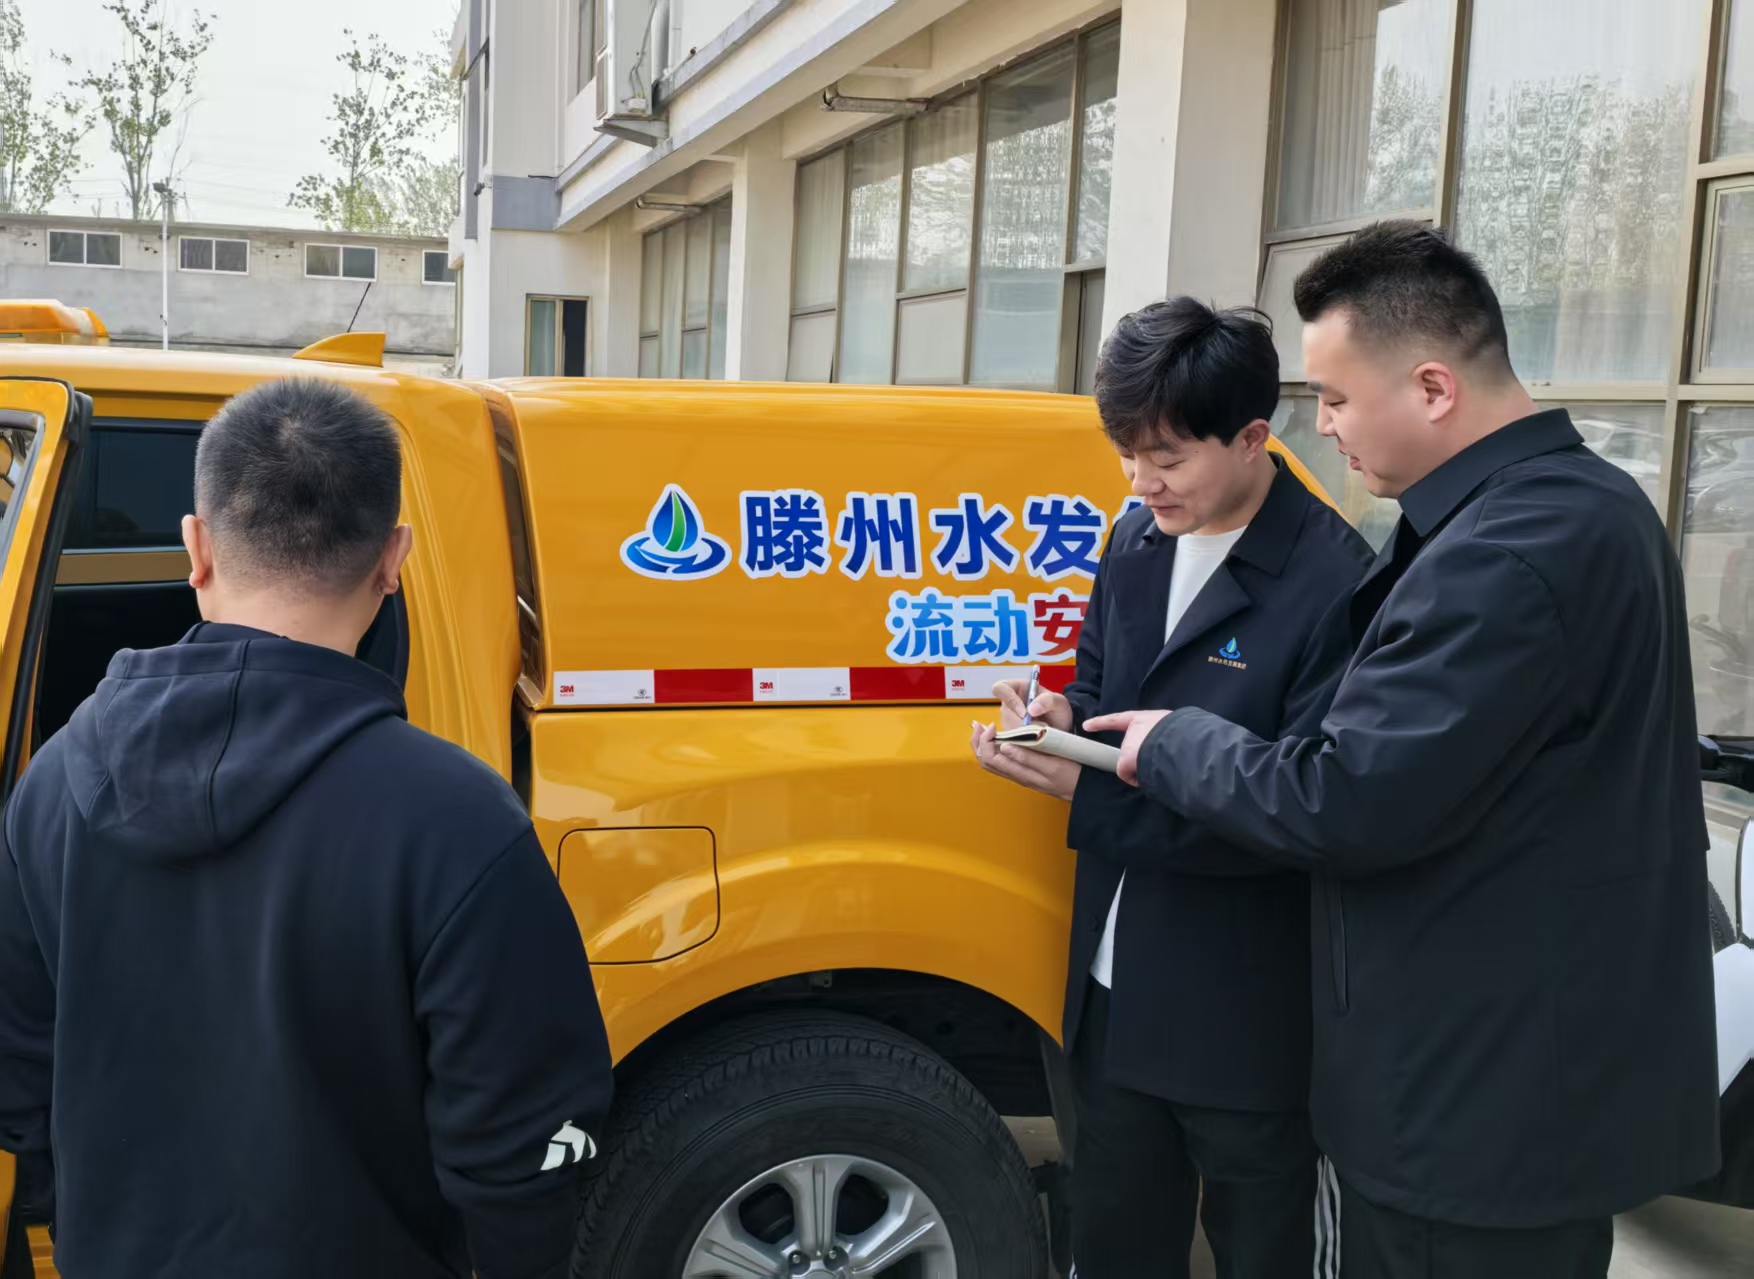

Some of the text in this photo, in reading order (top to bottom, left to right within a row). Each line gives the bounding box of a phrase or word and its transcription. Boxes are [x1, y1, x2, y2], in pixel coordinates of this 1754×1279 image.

[745, 494, 1144, 576] 滕州水发
[892, 594, 1089, 657] 流动安
[759, 681, 774, 690] 3M
[951, 679, 965, 688] 3M
[559, 684, 575, 693] 3M
